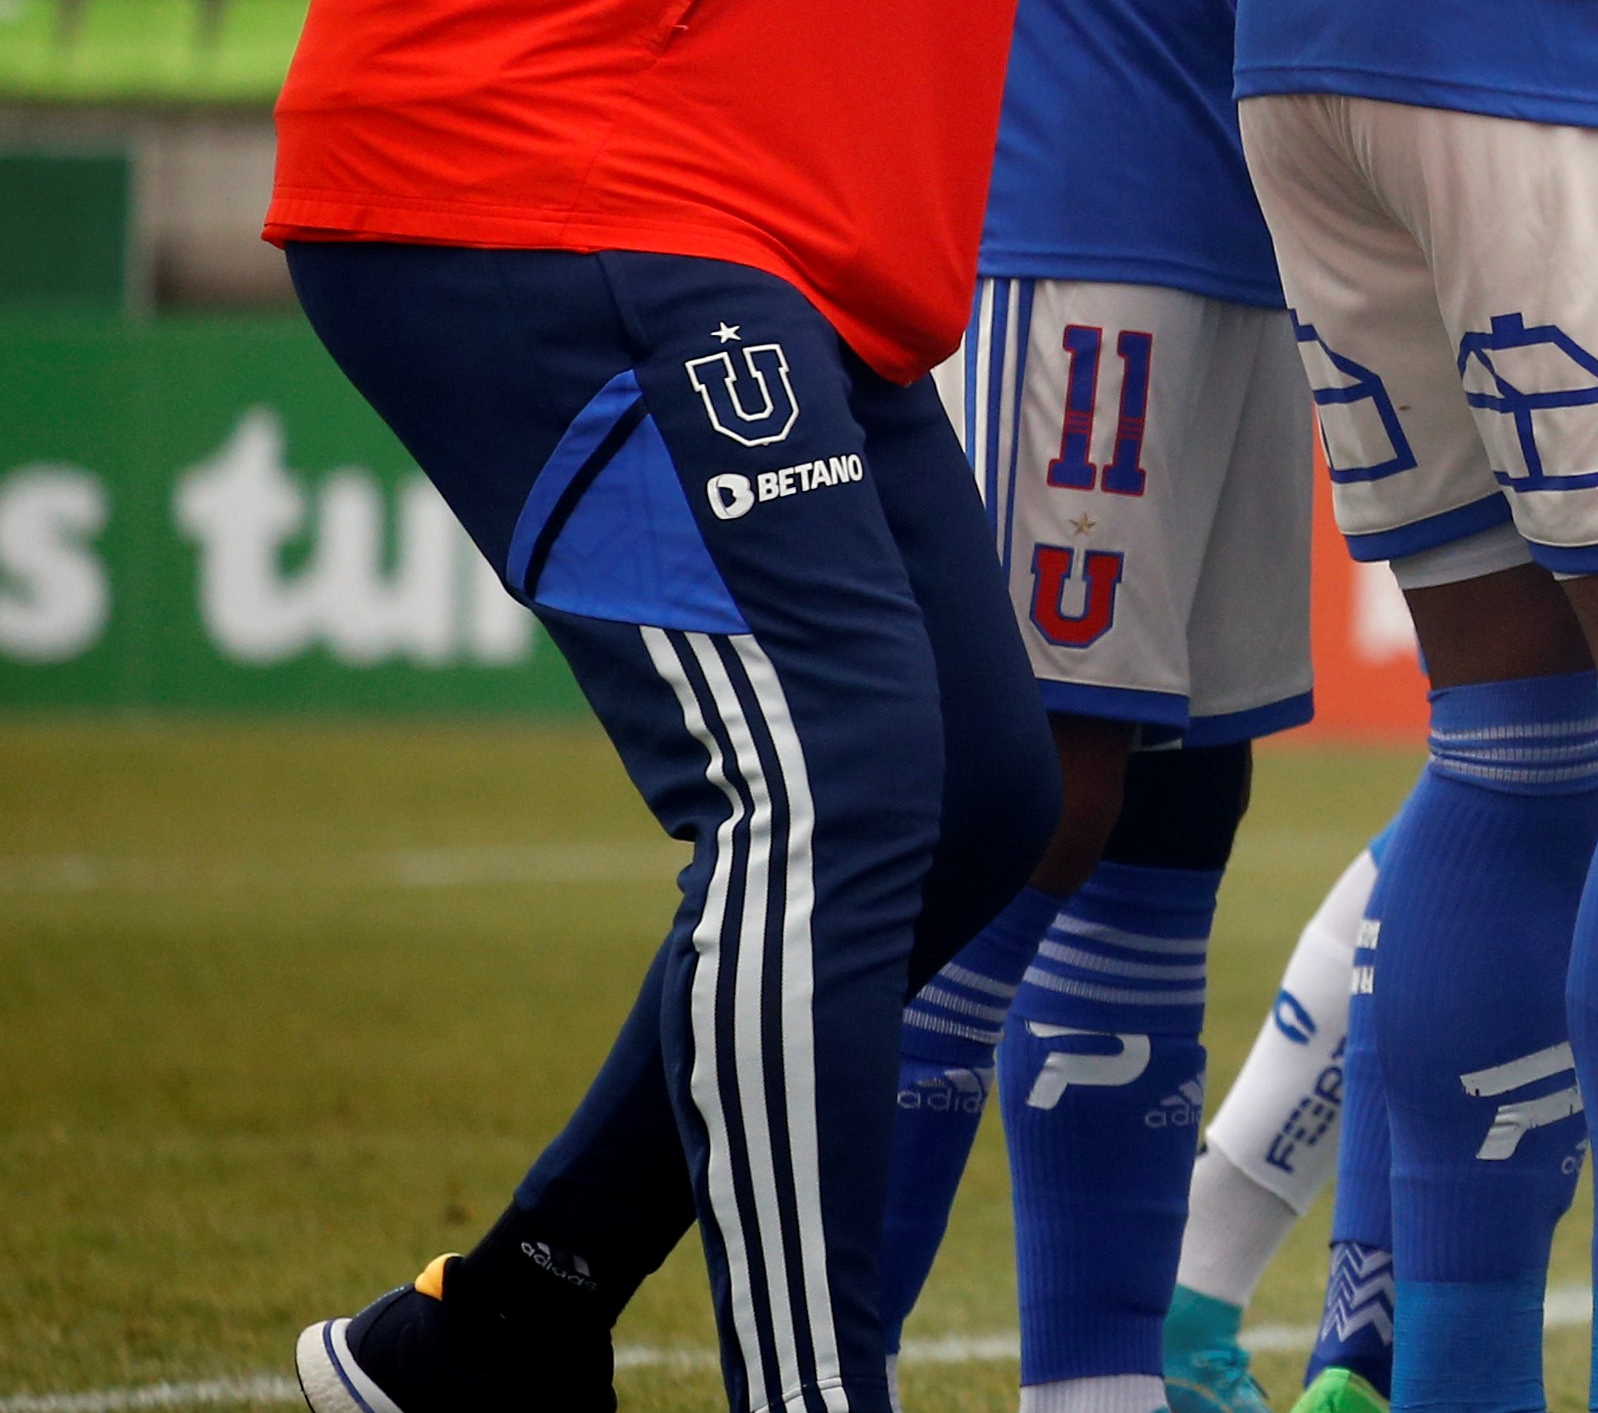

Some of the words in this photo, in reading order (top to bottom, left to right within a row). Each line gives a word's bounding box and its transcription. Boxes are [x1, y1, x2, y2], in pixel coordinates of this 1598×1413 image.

[684, 343, 800, 447] U
[1046, 323, 1153, 497] 11
[756, 453, 864, 502] BETANO
[1029, 541, 1124, 649] U
